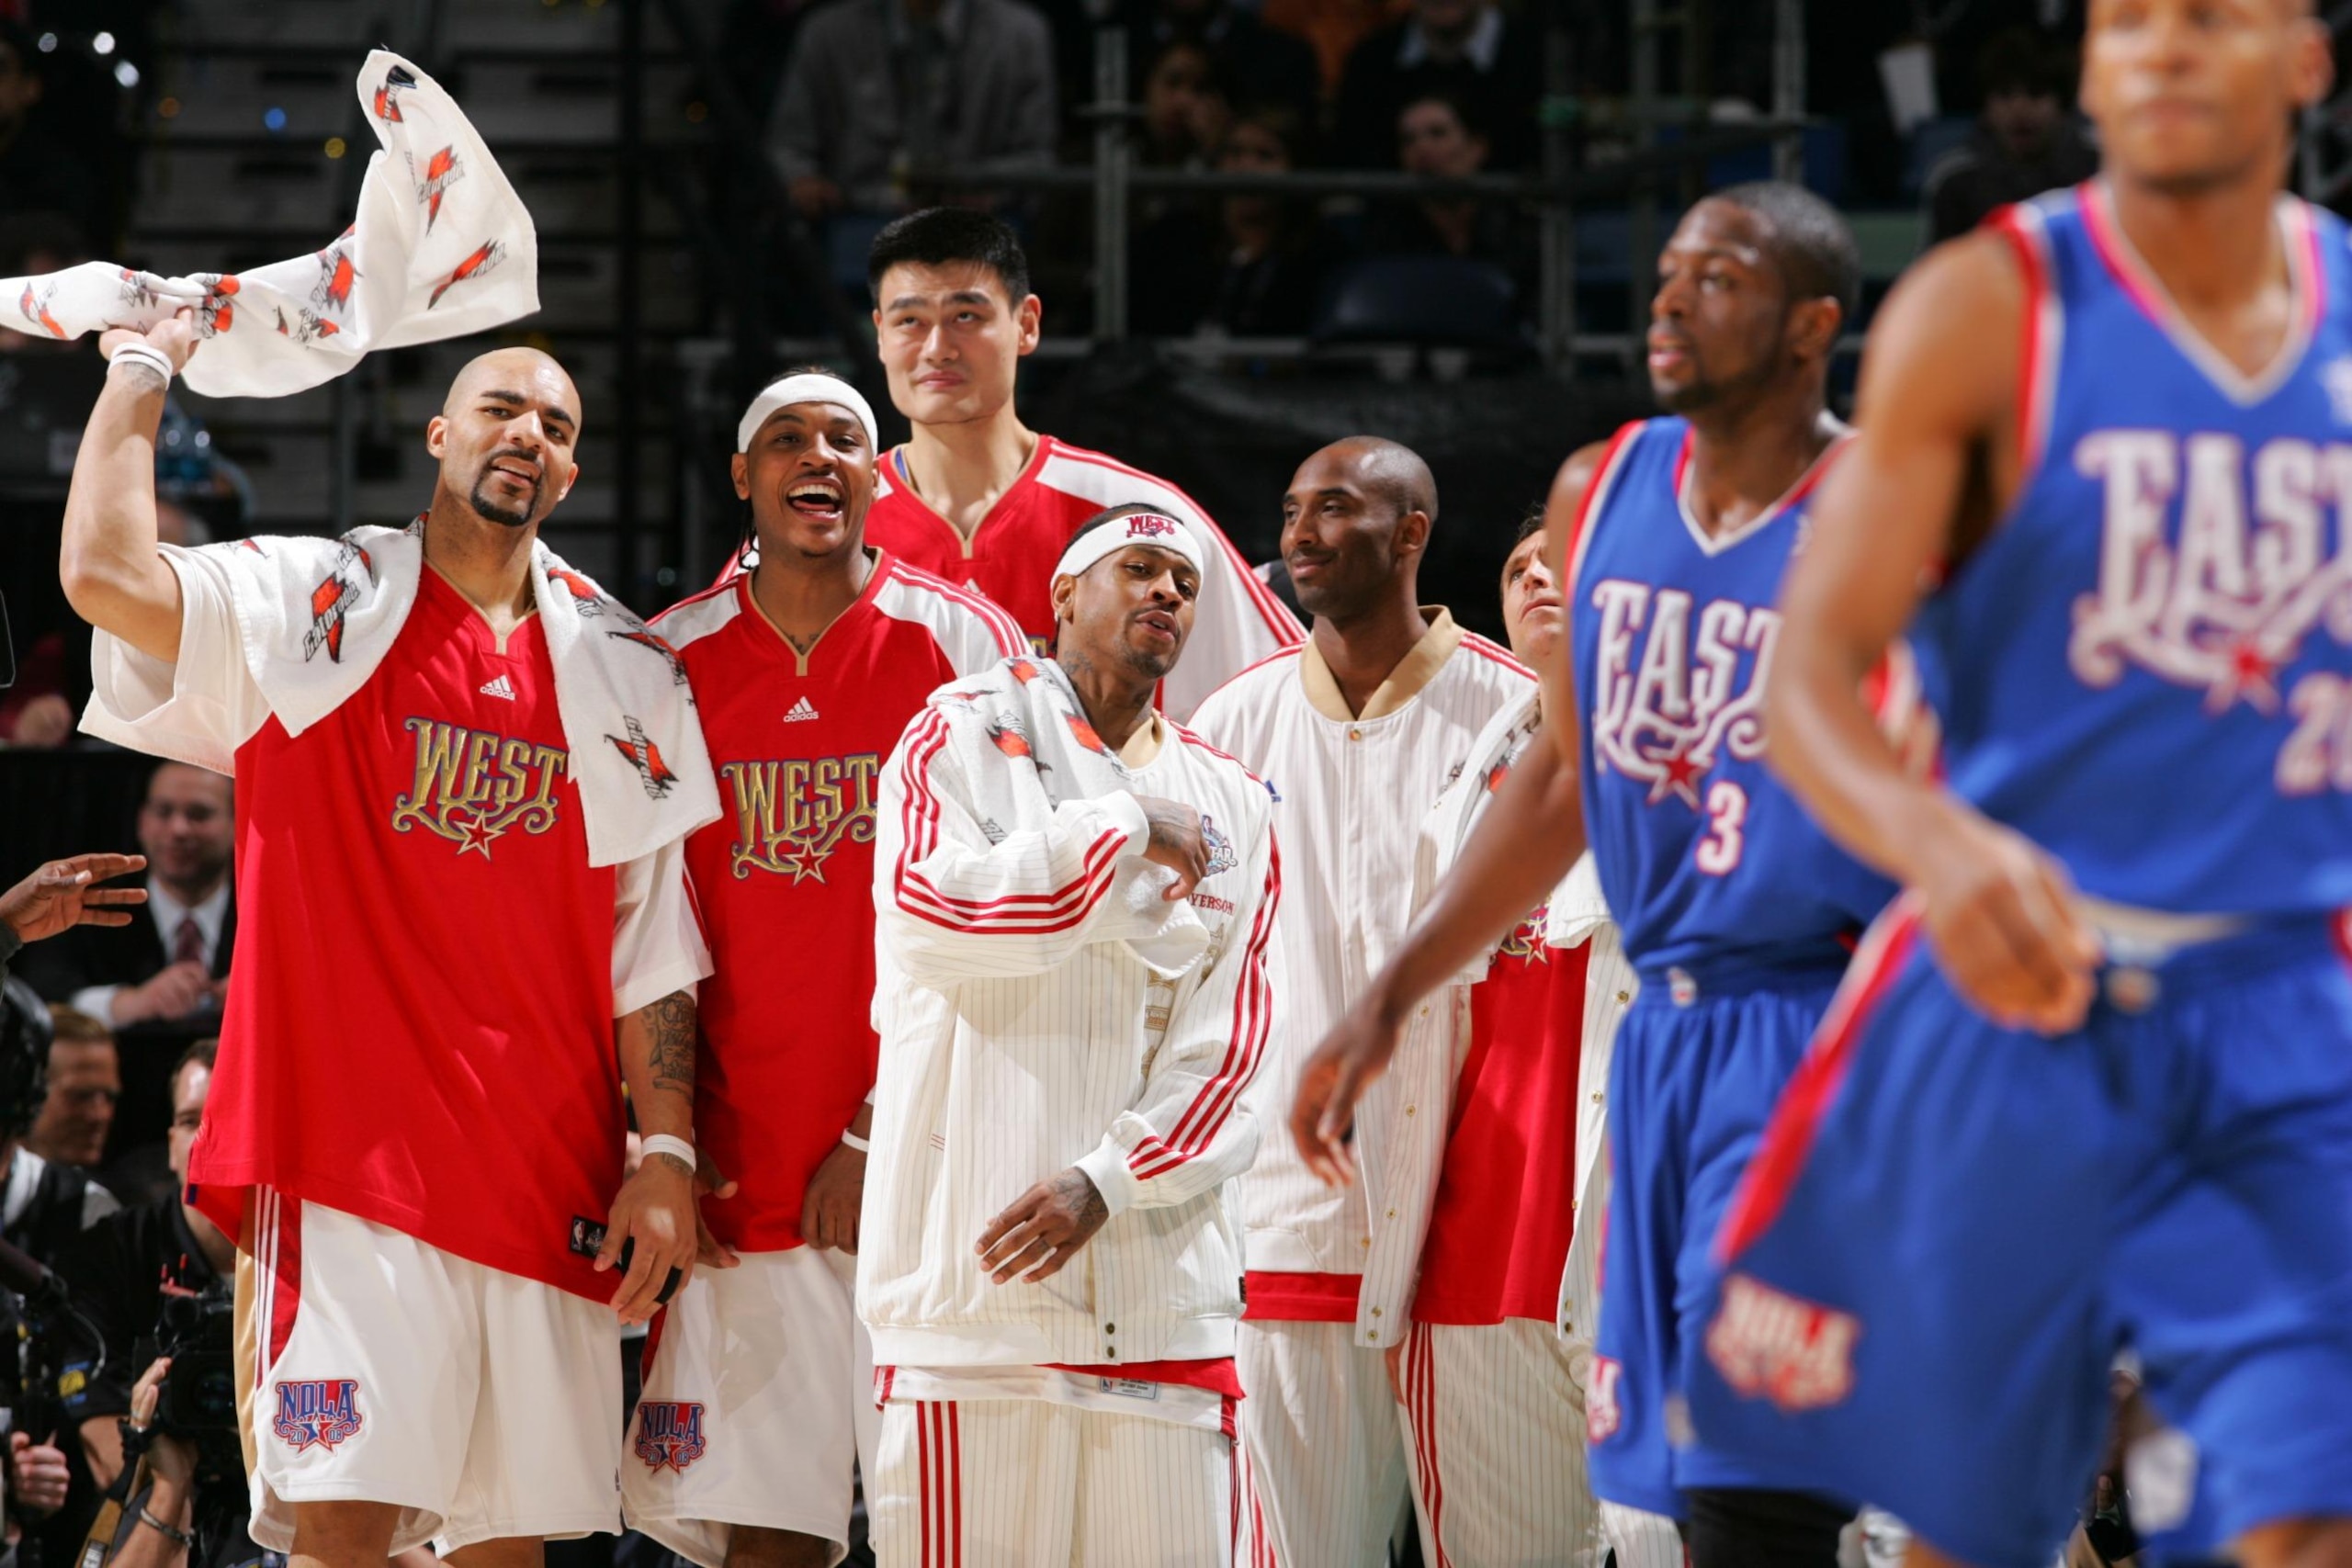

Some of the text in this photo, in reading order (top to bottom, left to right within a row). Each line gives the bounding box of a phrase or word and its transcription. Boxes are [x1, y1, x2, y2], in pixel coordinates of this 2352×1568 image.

[1125, 514, 1175, 538] WEST
[303, 581, 361, 663] Gatorade
[480, 685, 516, 701] adidas
[783, 711, 820, 723] adidas
[391, 716, 570, 841] WEST
[623, 715, 669, 801] Gatorade
[720, 752, 880, 880] WEST
[1696, 780, 1748, 875] 3
[275, 1382, 360, 1434] NOLA
[637, 1404, 705, 1456] NOLA
[289, 1428, 344, 1443] 20 08
